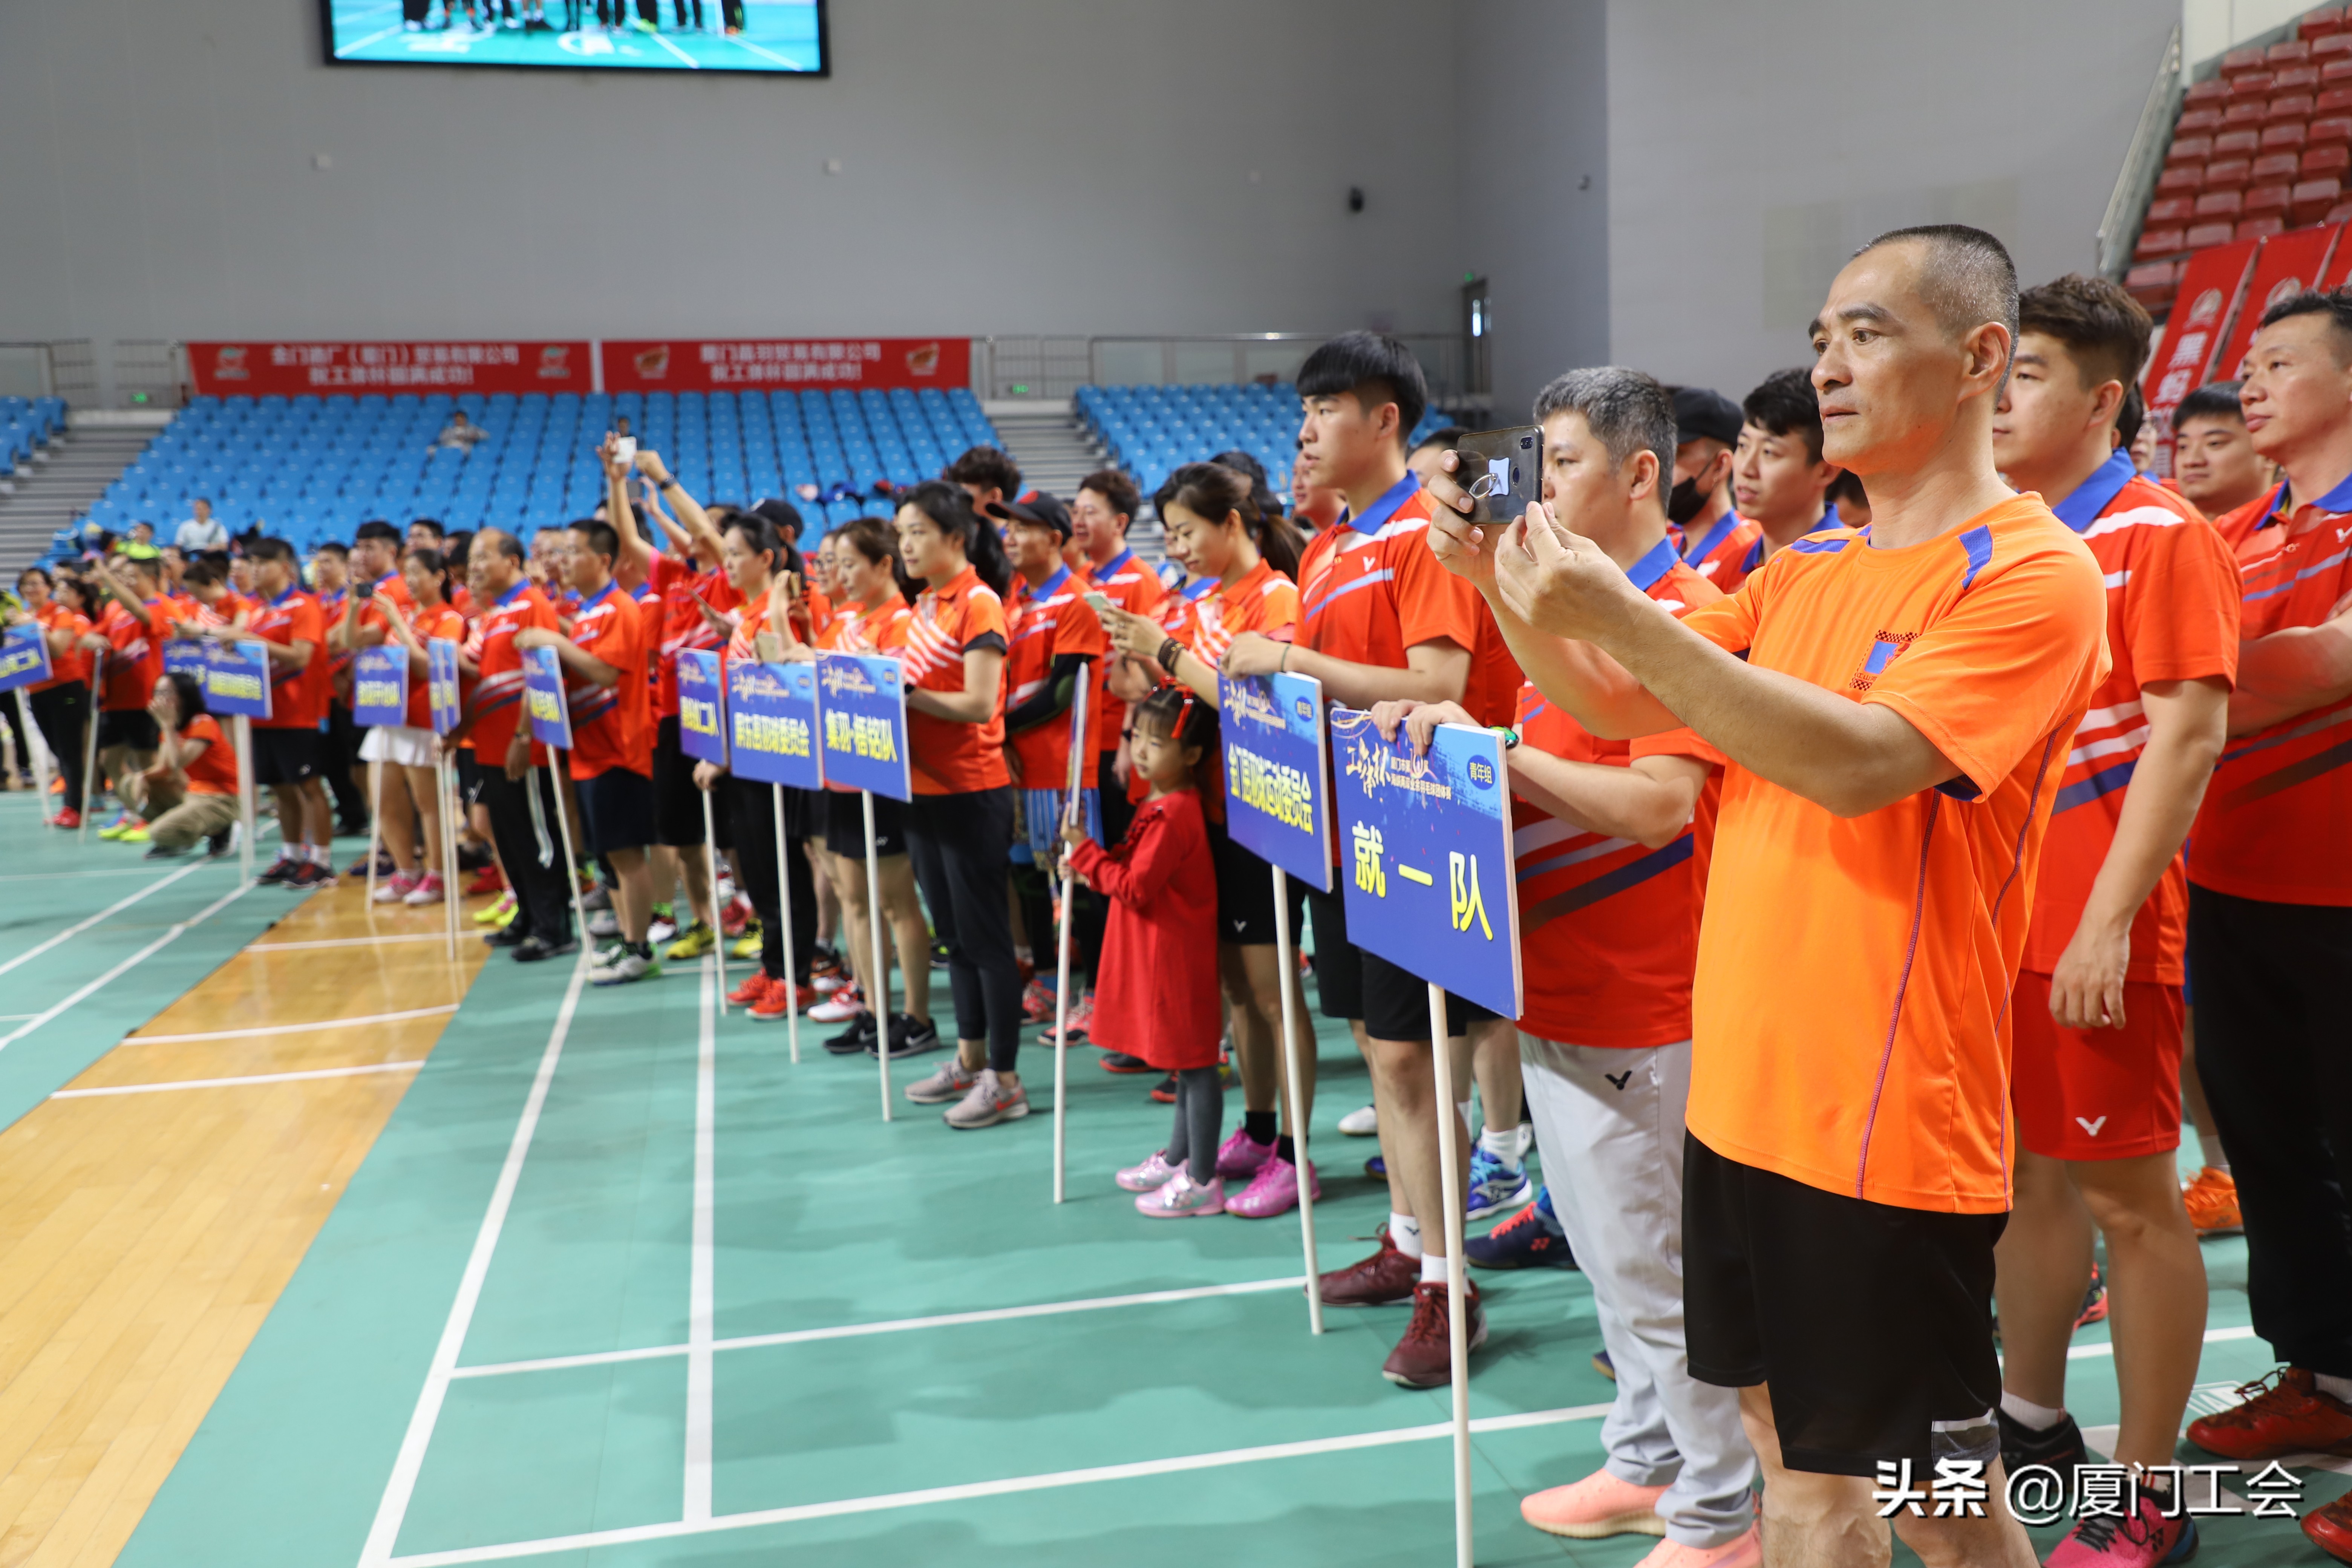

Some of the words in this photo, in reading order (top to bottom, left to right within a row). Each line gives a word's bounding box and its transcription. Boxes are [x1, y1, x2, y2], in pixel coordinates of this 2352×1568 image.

[1470, 762, 1493, 784] 青年组
[1352, 820, 1494, 941] 就一队
